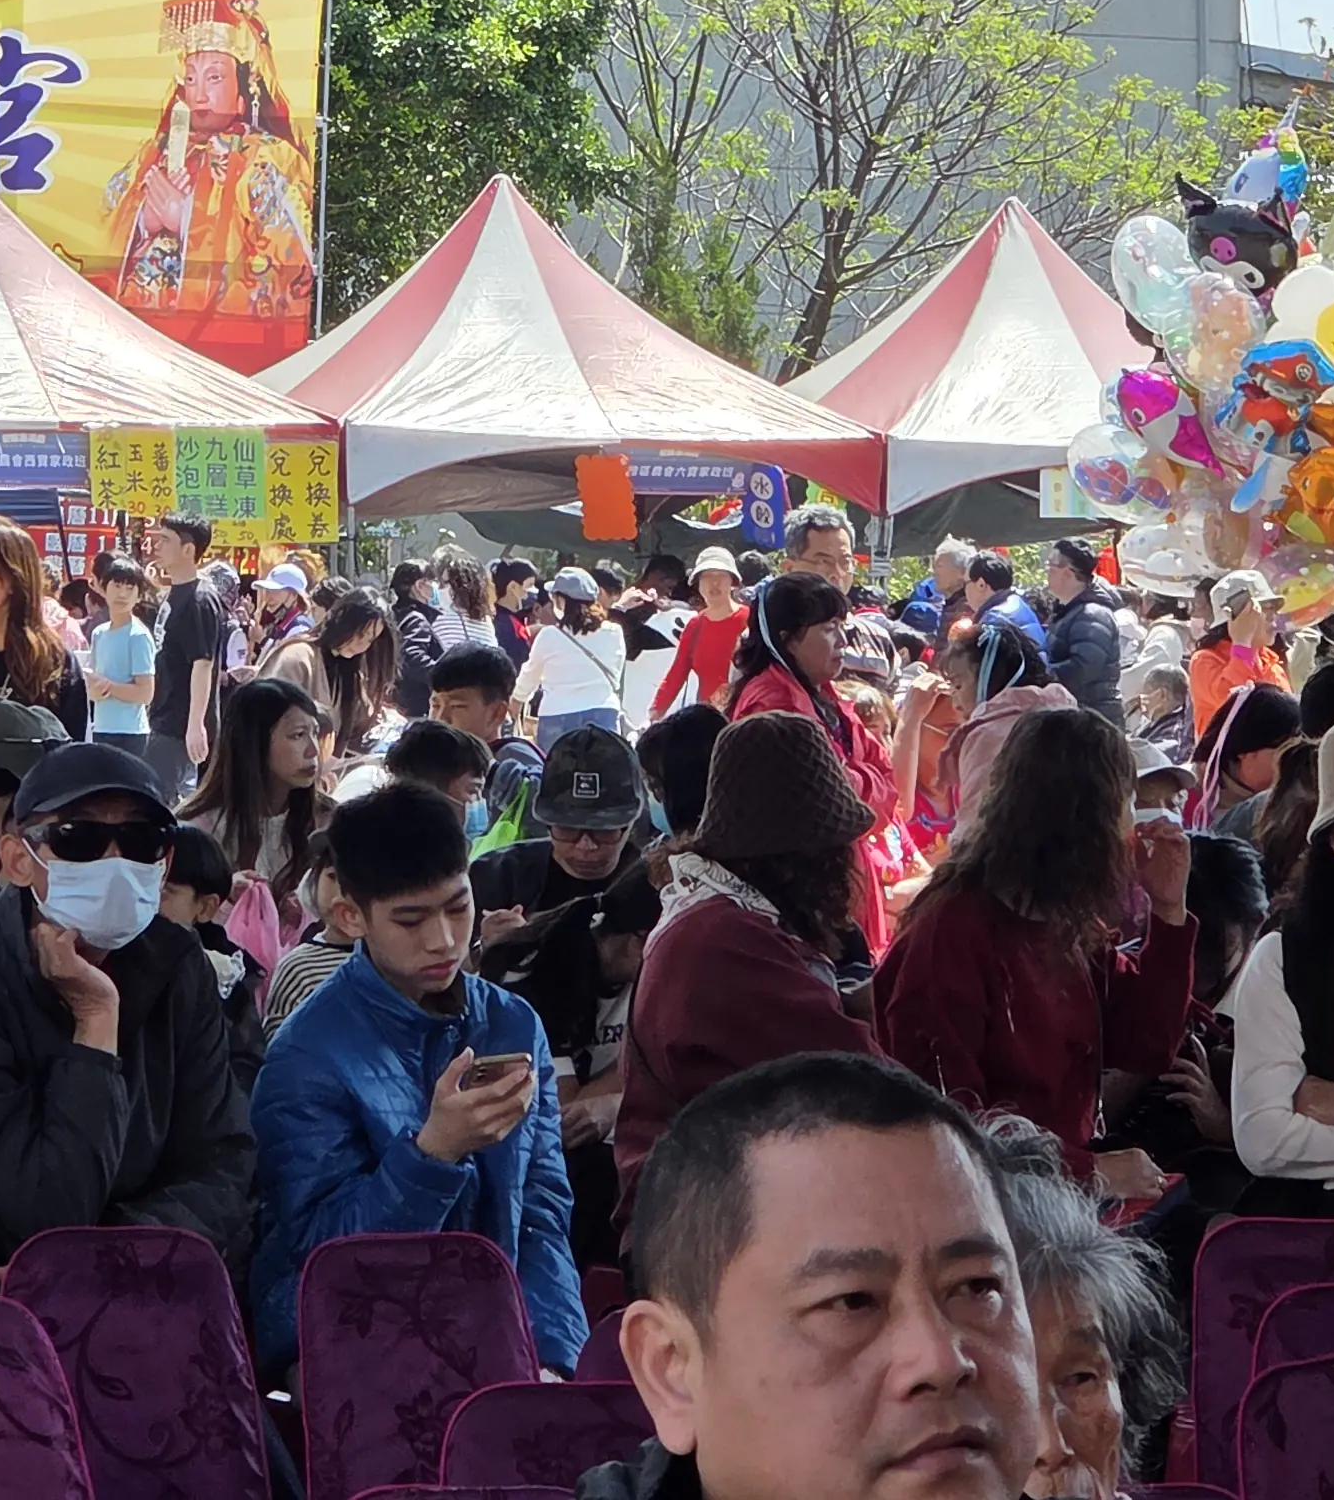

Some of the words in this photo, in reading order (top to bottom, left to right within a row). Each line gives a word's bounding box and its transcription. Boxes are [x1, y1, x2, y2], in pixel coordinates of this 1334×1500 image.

[95, 444, 121, 509] 紅茶
[126, 443, 148, 492] 玉米
[233, 438, 257, 518] 仙草凍
